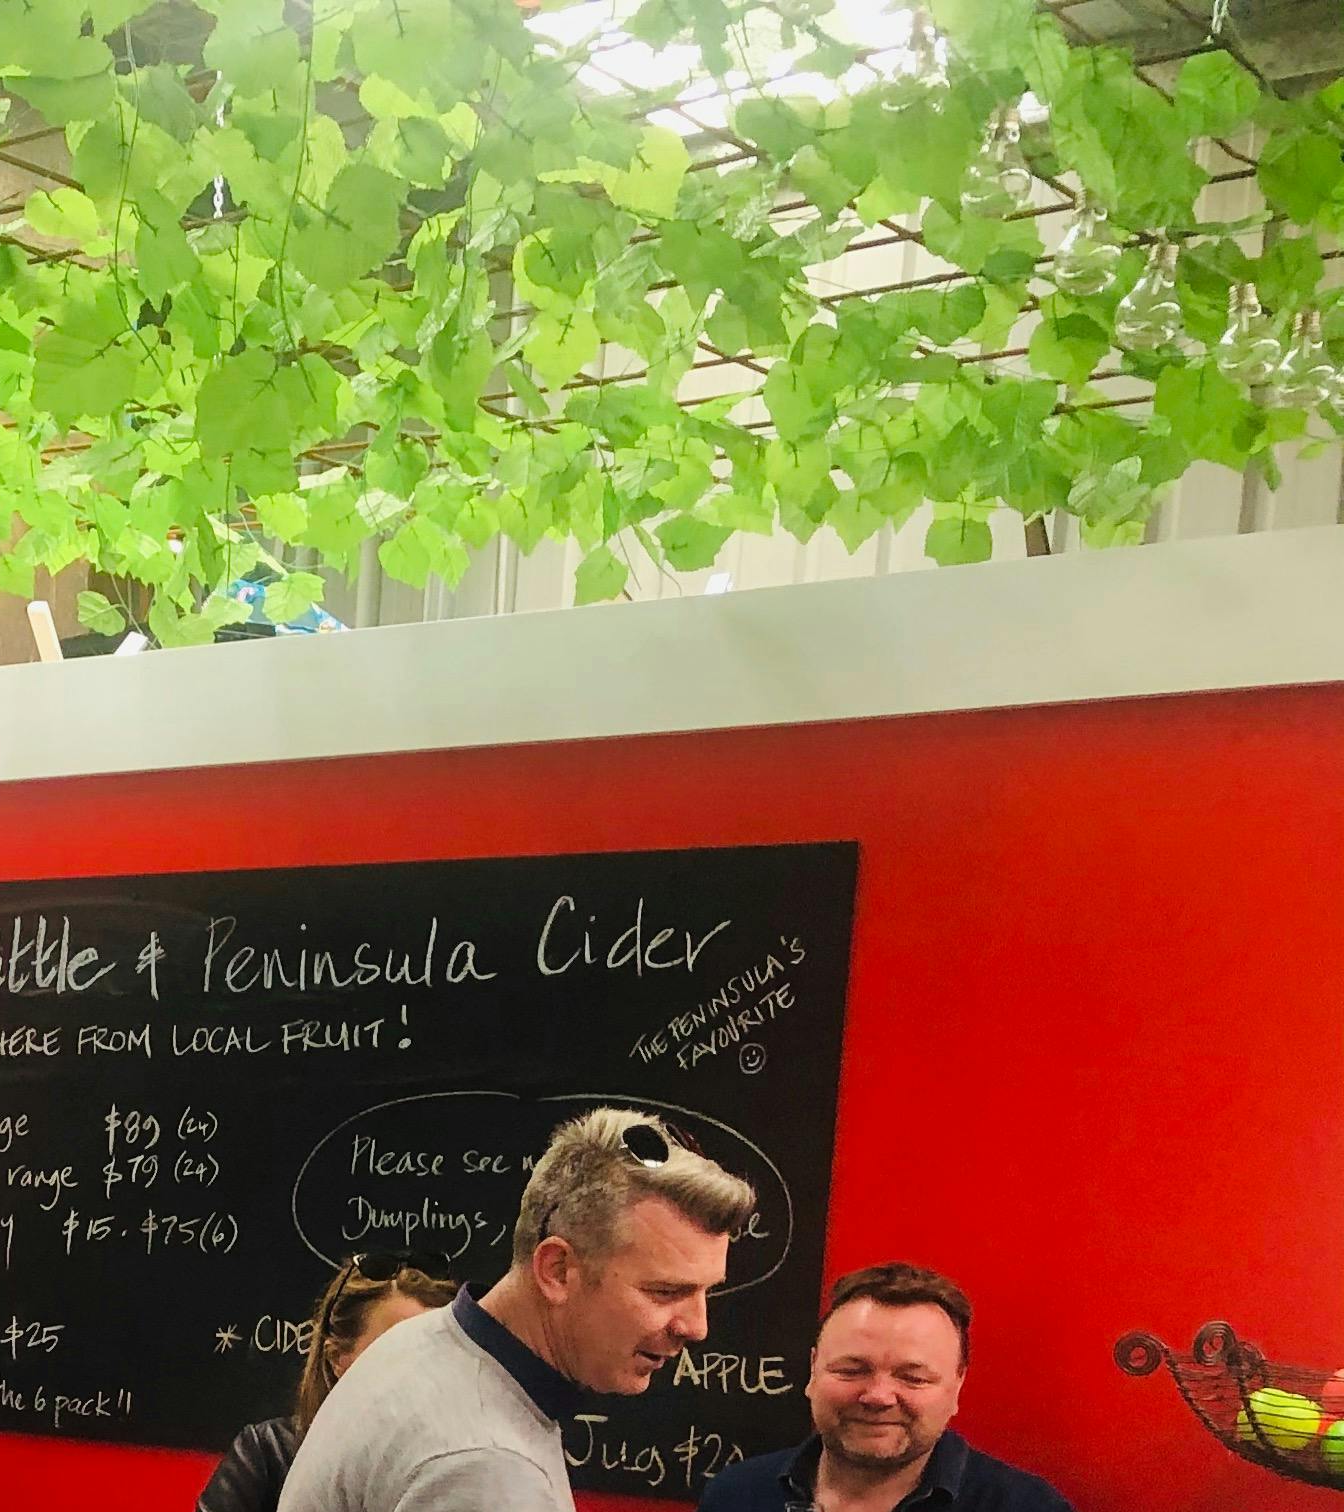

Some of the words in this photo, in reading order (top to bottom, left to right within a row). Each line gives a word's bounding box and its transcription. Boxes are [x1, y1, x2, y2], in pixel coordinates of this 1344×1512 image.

[203, 916, 499, 993] Peninsula
[535, 895, 732, 977] Cider
[629, 1031, 669, 1063] THE
[668, 936, 806, 1042] PENINSULA'S
[676, 982, 795, 1070] FAVOURITE
[77, 1023, 152, 1059] FROM
[172, 1023, 272, 1058] LOCAL
[103, 1103, 161, 1154] $89
[177, 1106, 219, 1143] (24)
[349, 1134, 444, 1177] Please
[463, 1150, 511, 1176] see
[8, 1164, 79, 1211] range
[102, 1153, 159, 1199] $79
[174, 1150, 220, 1187] (24)
[342, 1195, 509, 1259] Dumplings,
[0, 1316, 65, 1359] $25
[254, 1315, 315, 1354] CIDE
[673, 1347, 793, 1395] APPLE
[35, 1385, 47, 1412] 6
[563, 1414, 666, 1487] Jug
